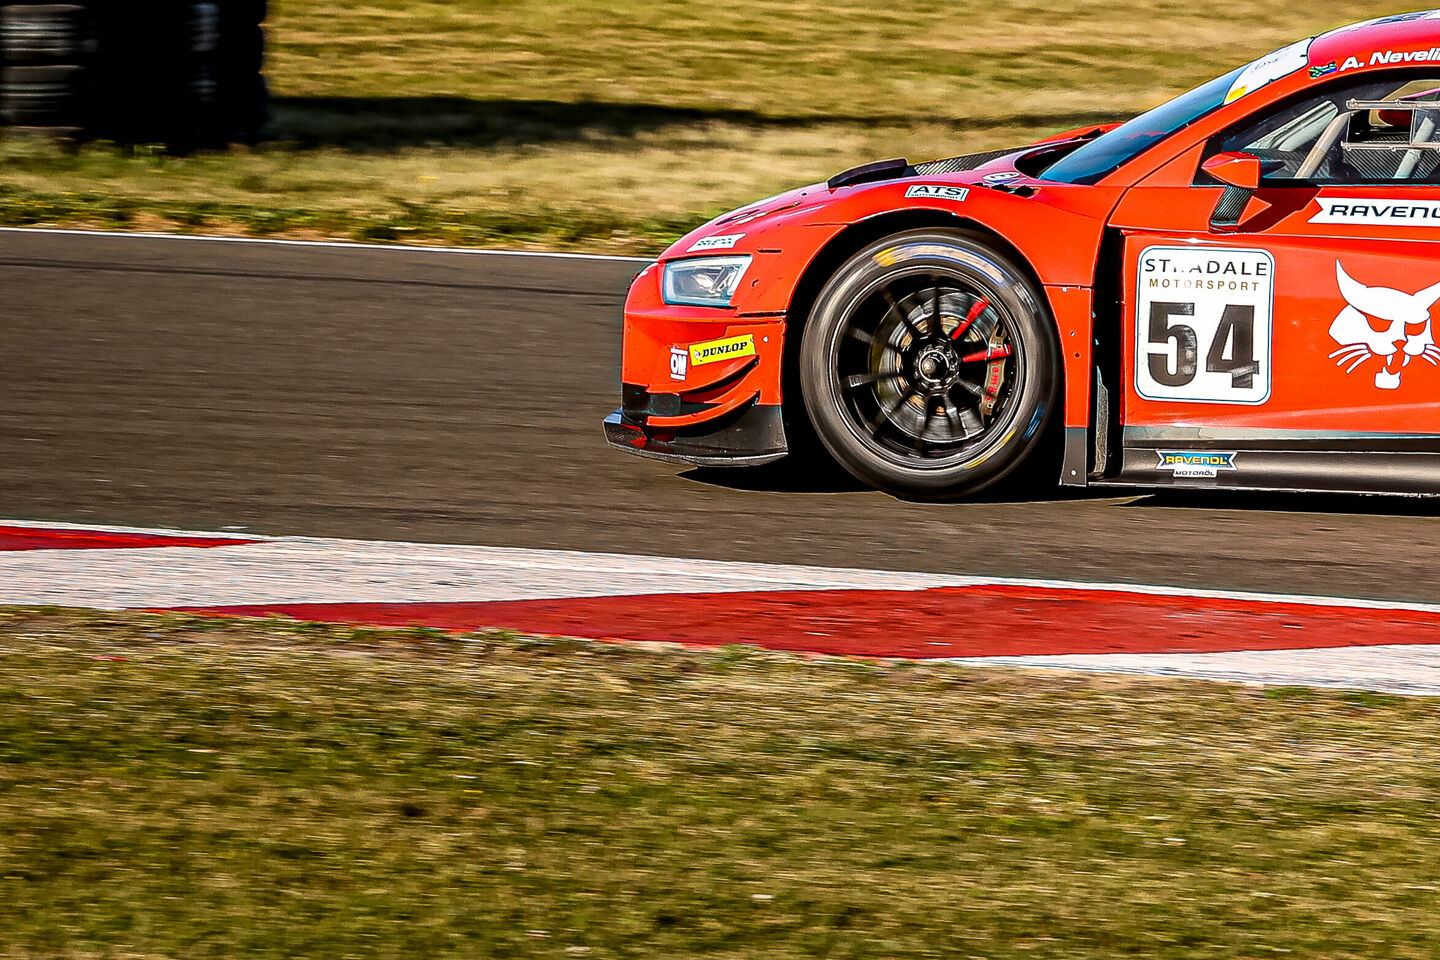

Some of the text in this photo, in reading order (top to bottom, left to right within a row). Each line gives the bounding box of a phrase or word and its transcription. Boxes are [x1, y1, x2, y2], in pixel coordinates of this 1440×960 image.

[1338, 56, 1365, 72] A.
[914, 185, 961, 196] ATS
[1149, 278, 1260, 292] MOTORSPORT
[702, 341, 748, 358] DUNLOP
[1147, 300, 1260, 390] 54
[1165, 455, 1228, 465] RAVENOL
